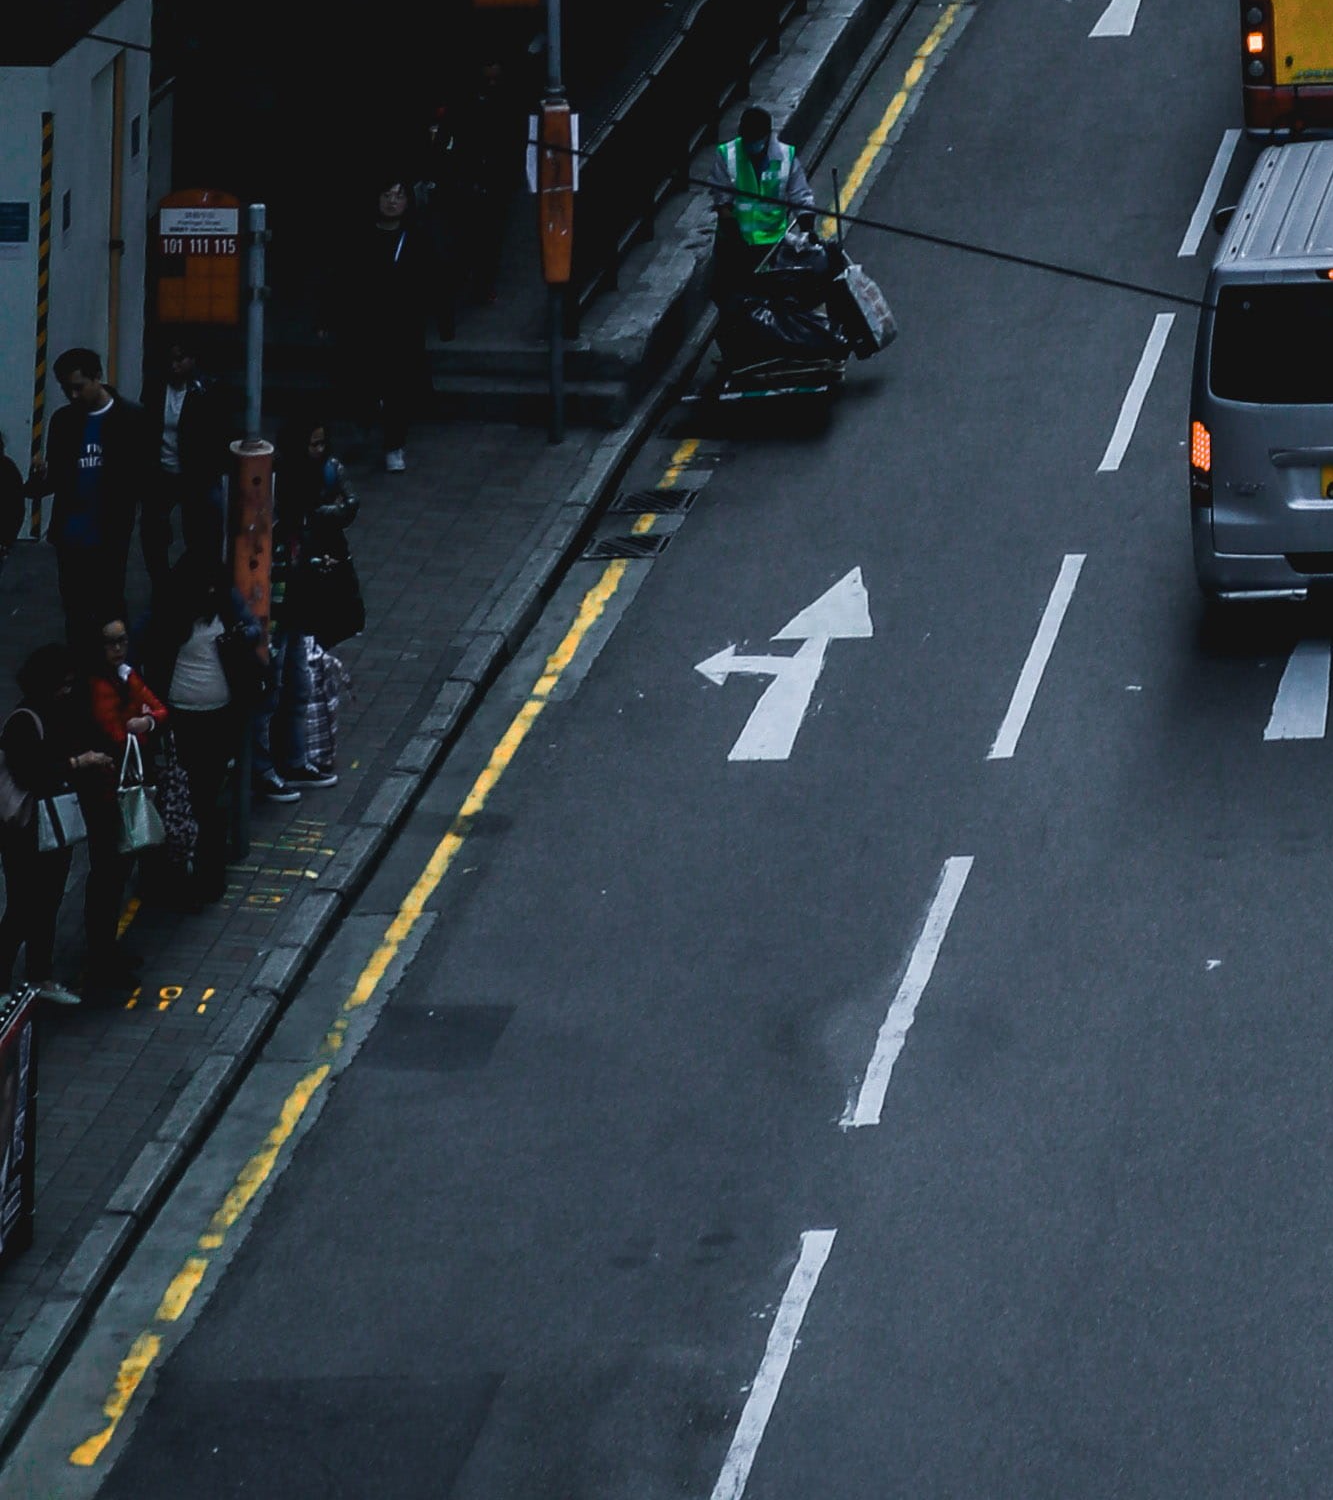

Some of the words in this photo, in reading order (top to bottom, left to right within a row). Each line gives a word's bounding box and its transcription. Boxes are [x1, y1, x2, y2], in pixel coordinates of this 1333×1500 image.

[162, 238, 184, 255] 101
[189, 238, 209, 255] 111
[213, 238, 237, 255] 115
